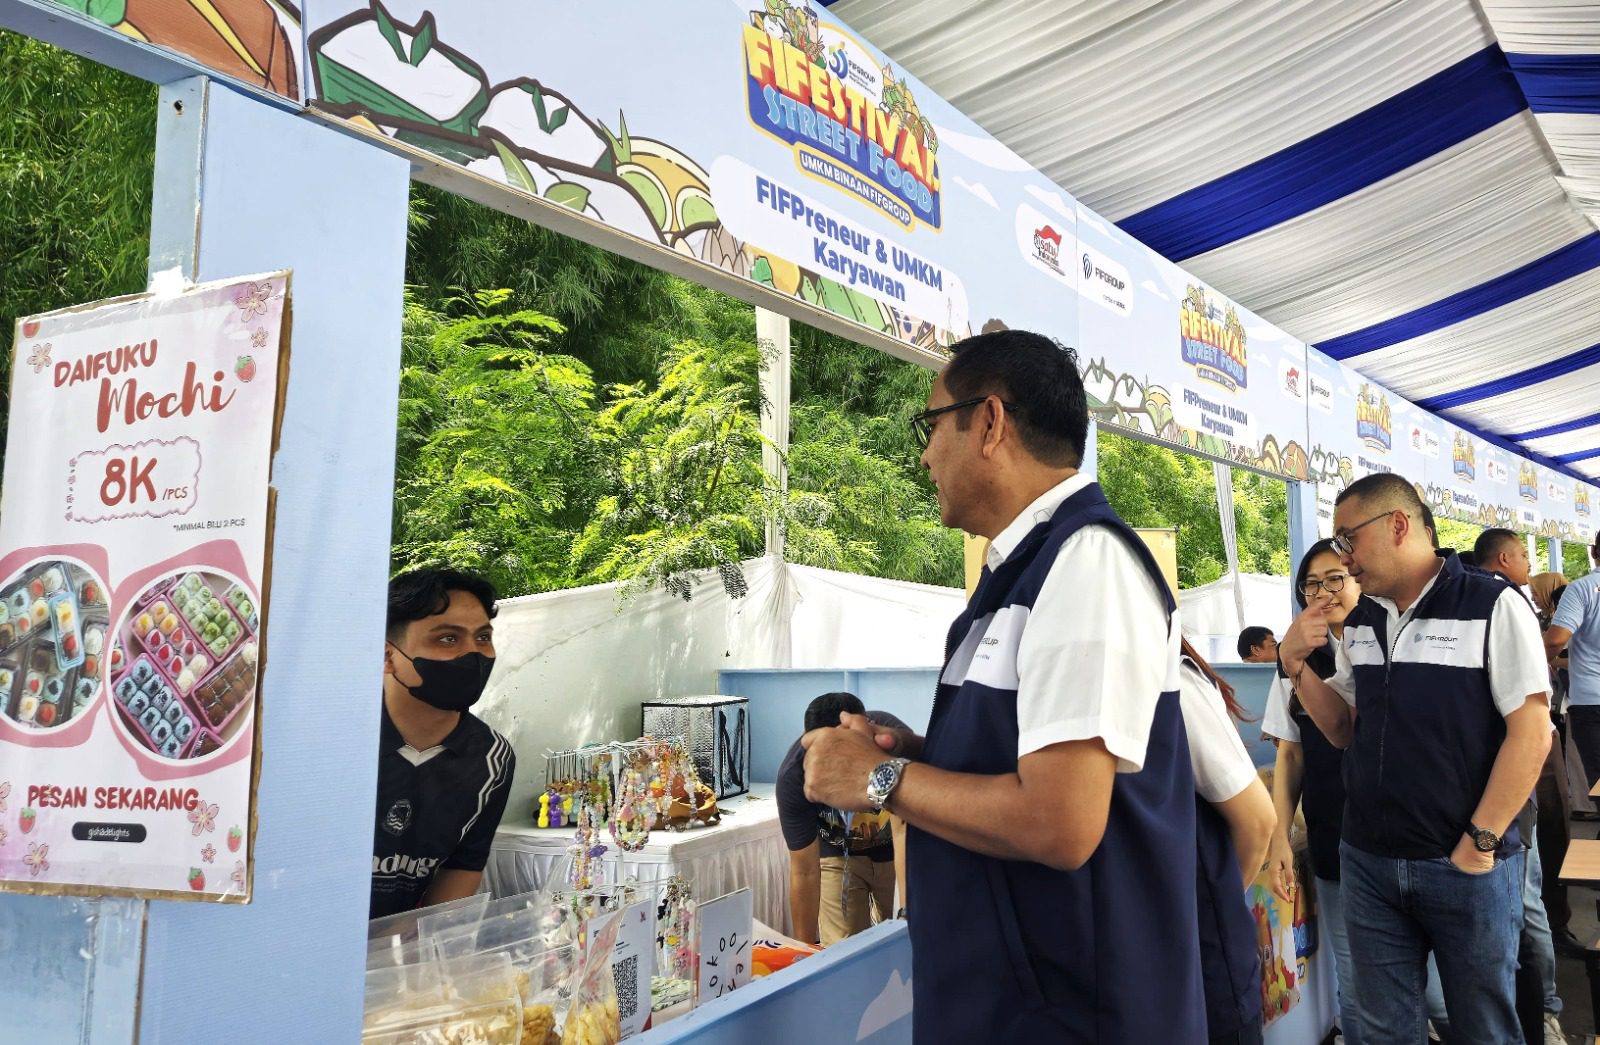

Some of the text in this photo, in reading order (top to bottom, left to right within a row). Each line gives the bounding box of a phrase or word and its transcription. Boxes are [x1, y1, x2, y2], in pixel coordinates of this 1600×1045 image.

[743, 23, 940, 192] FIFESTIVAL
[762, 83, 932, 214] STREET FOOD
[801, 153, 911, 222] UMKM BINAAN FIFGROUP
[756, 176, 943, 291] FIFPreneur & UMKM
[813, 237, 906, 302] Karyawan
[54, 338, 158, 388] DAIFUKU
[96, 361, 237, 433] Mochi
[99, 455, 189, 506] 8K /PCS
[230, 518, 246, 528] PCS
[28, 784, 200, 812] PESAN SEKARANG
